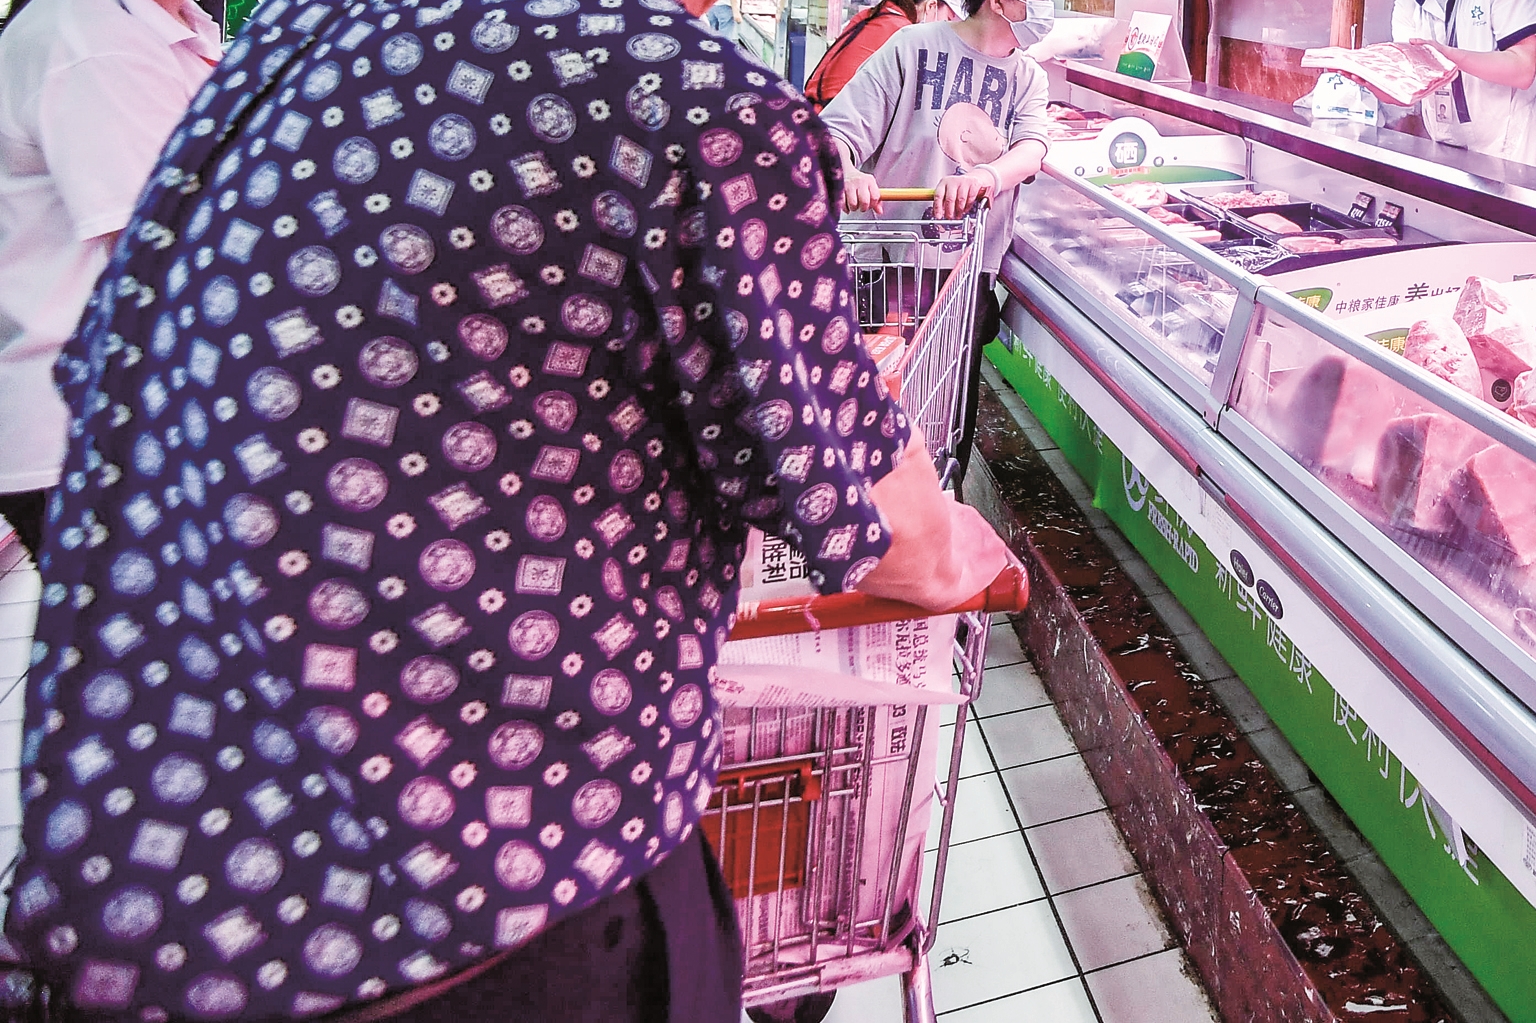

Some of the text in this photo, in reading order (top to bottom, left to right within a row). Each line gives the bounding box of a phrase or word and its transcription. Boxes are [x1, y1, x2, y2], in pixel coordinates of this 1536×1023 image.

[1114, 142, 1139, 164] 硒
[1335, 295, 1400, 315] 中粮家佳康
[1258, 585, 1280, 615] Carrier
